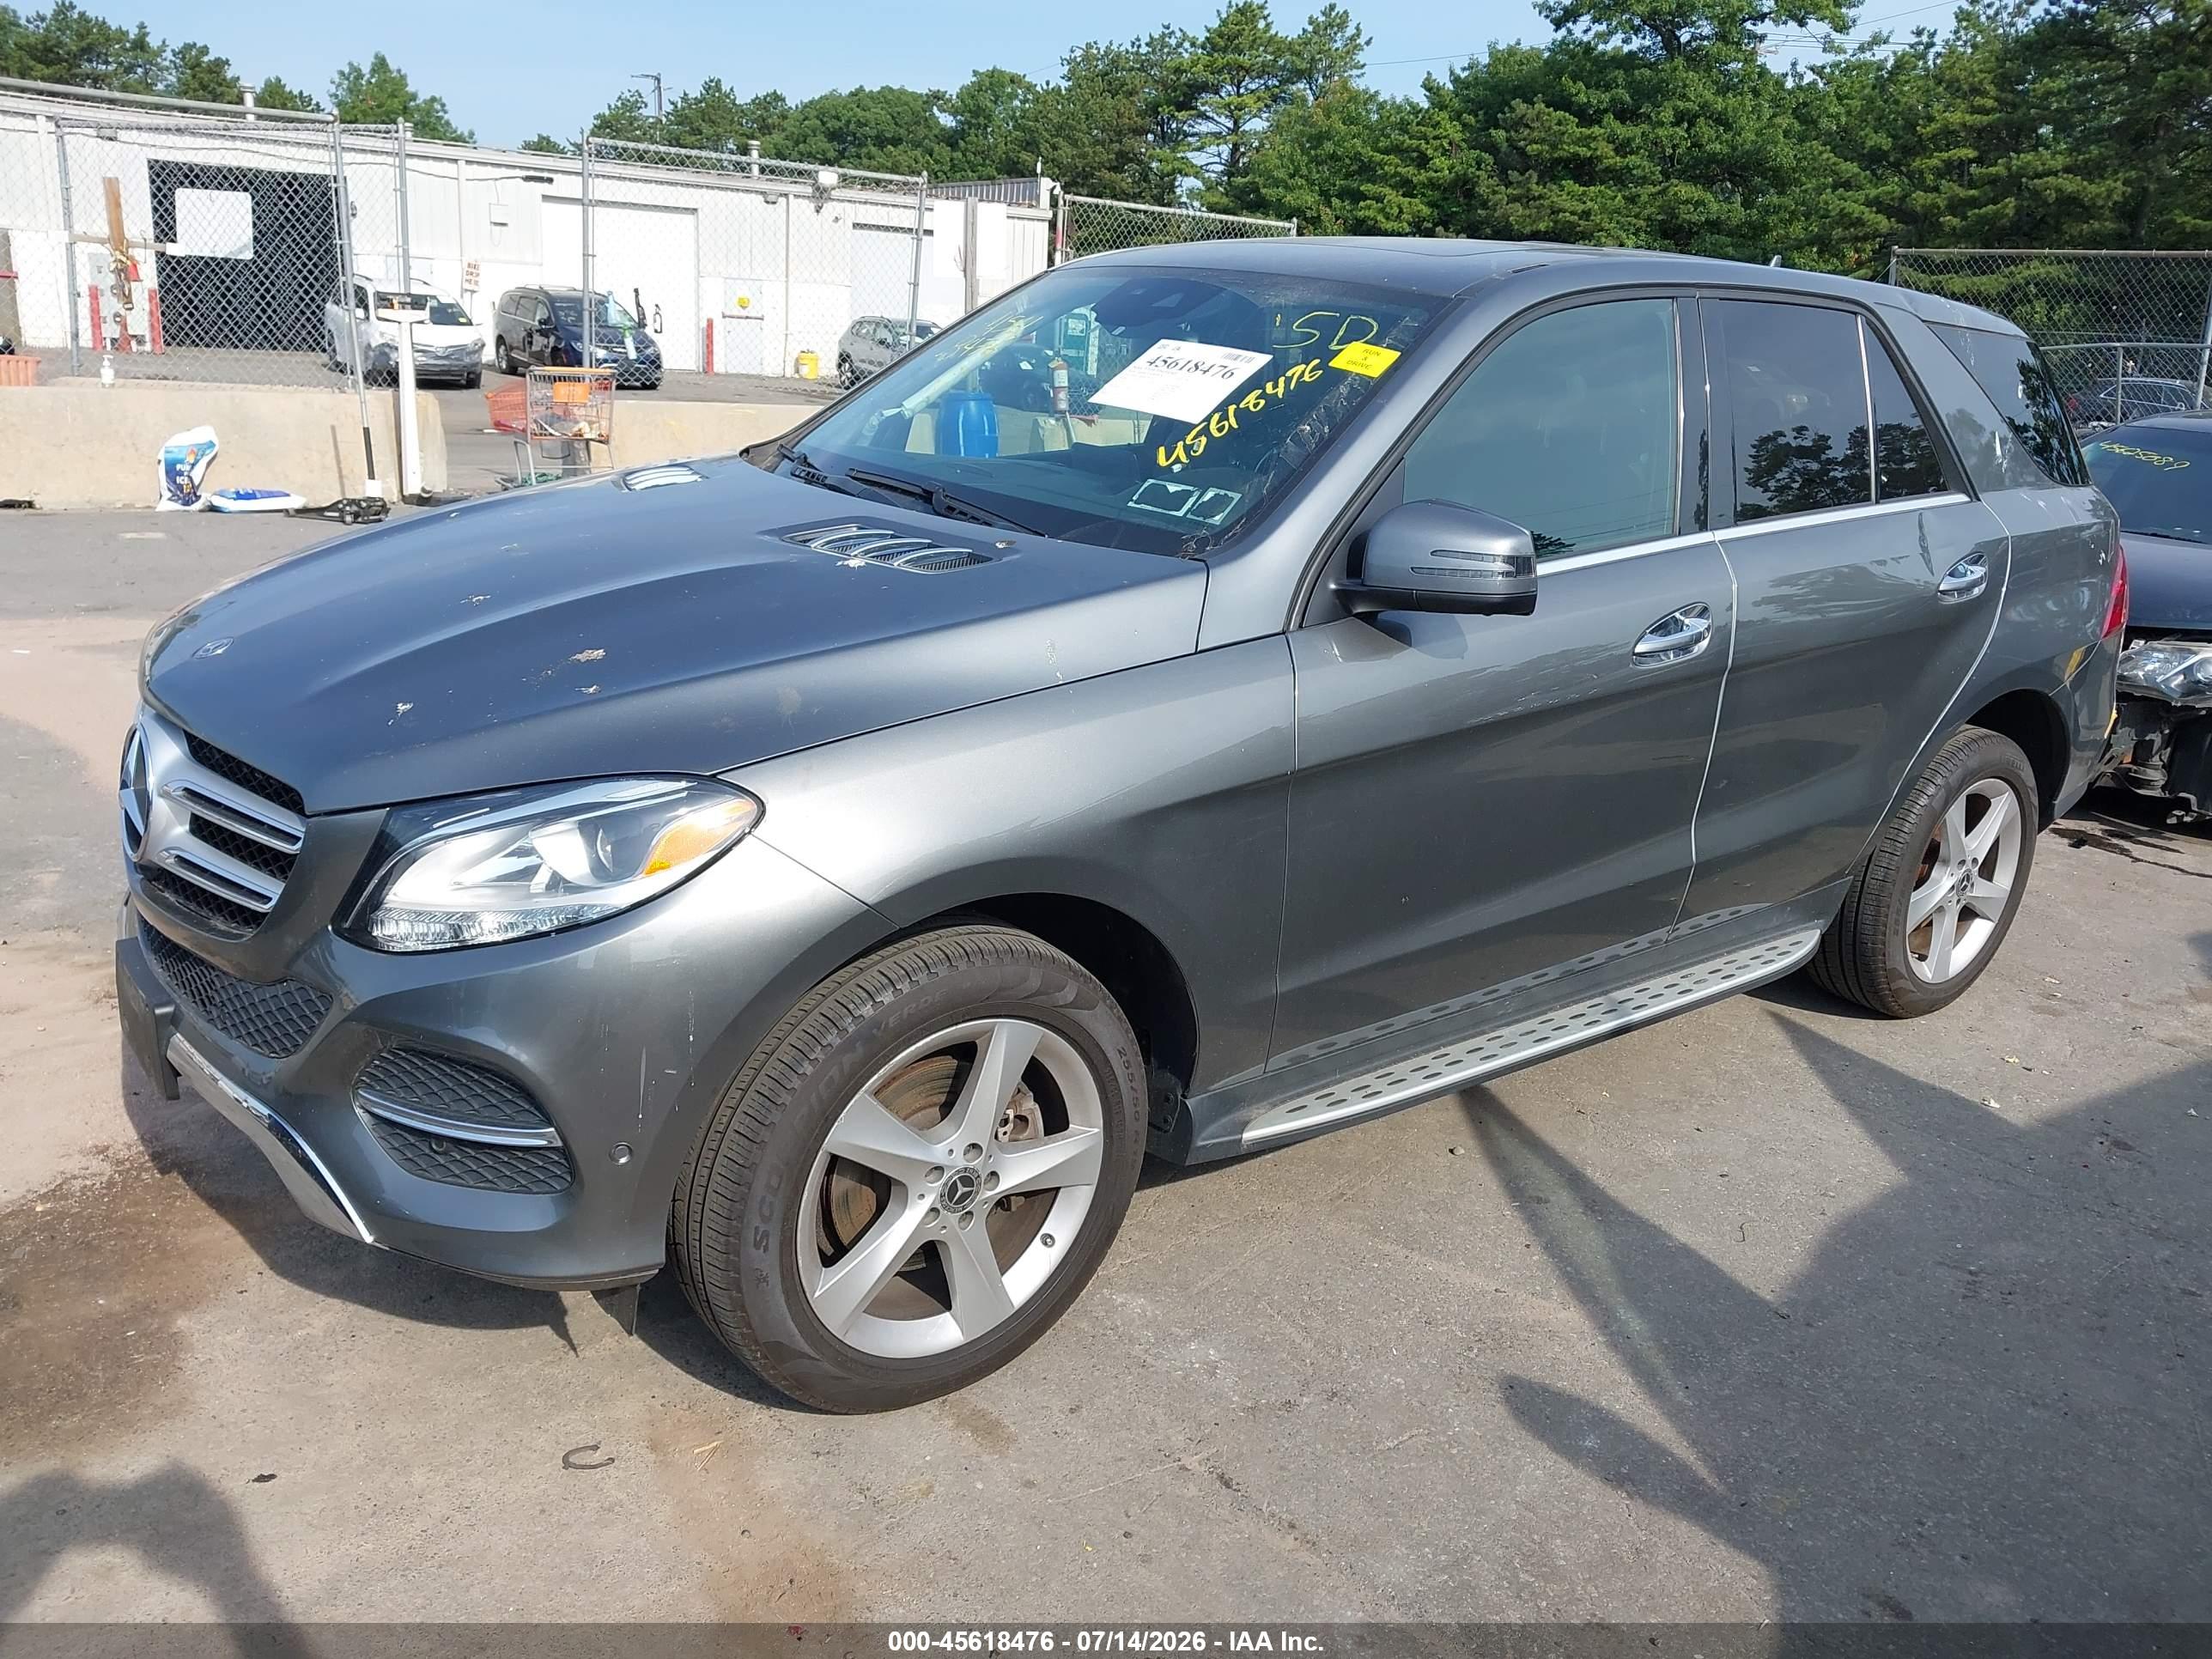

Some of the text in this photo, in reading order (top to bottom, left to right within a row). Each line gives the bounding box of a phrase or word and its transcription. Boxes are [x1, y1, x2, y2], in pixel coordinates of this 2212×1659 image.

[1363, 349, 1382, 357] RUN
[1146, 354, 1240, 380] 45618476
[1346, 360, 1373, 370] DRIVE
